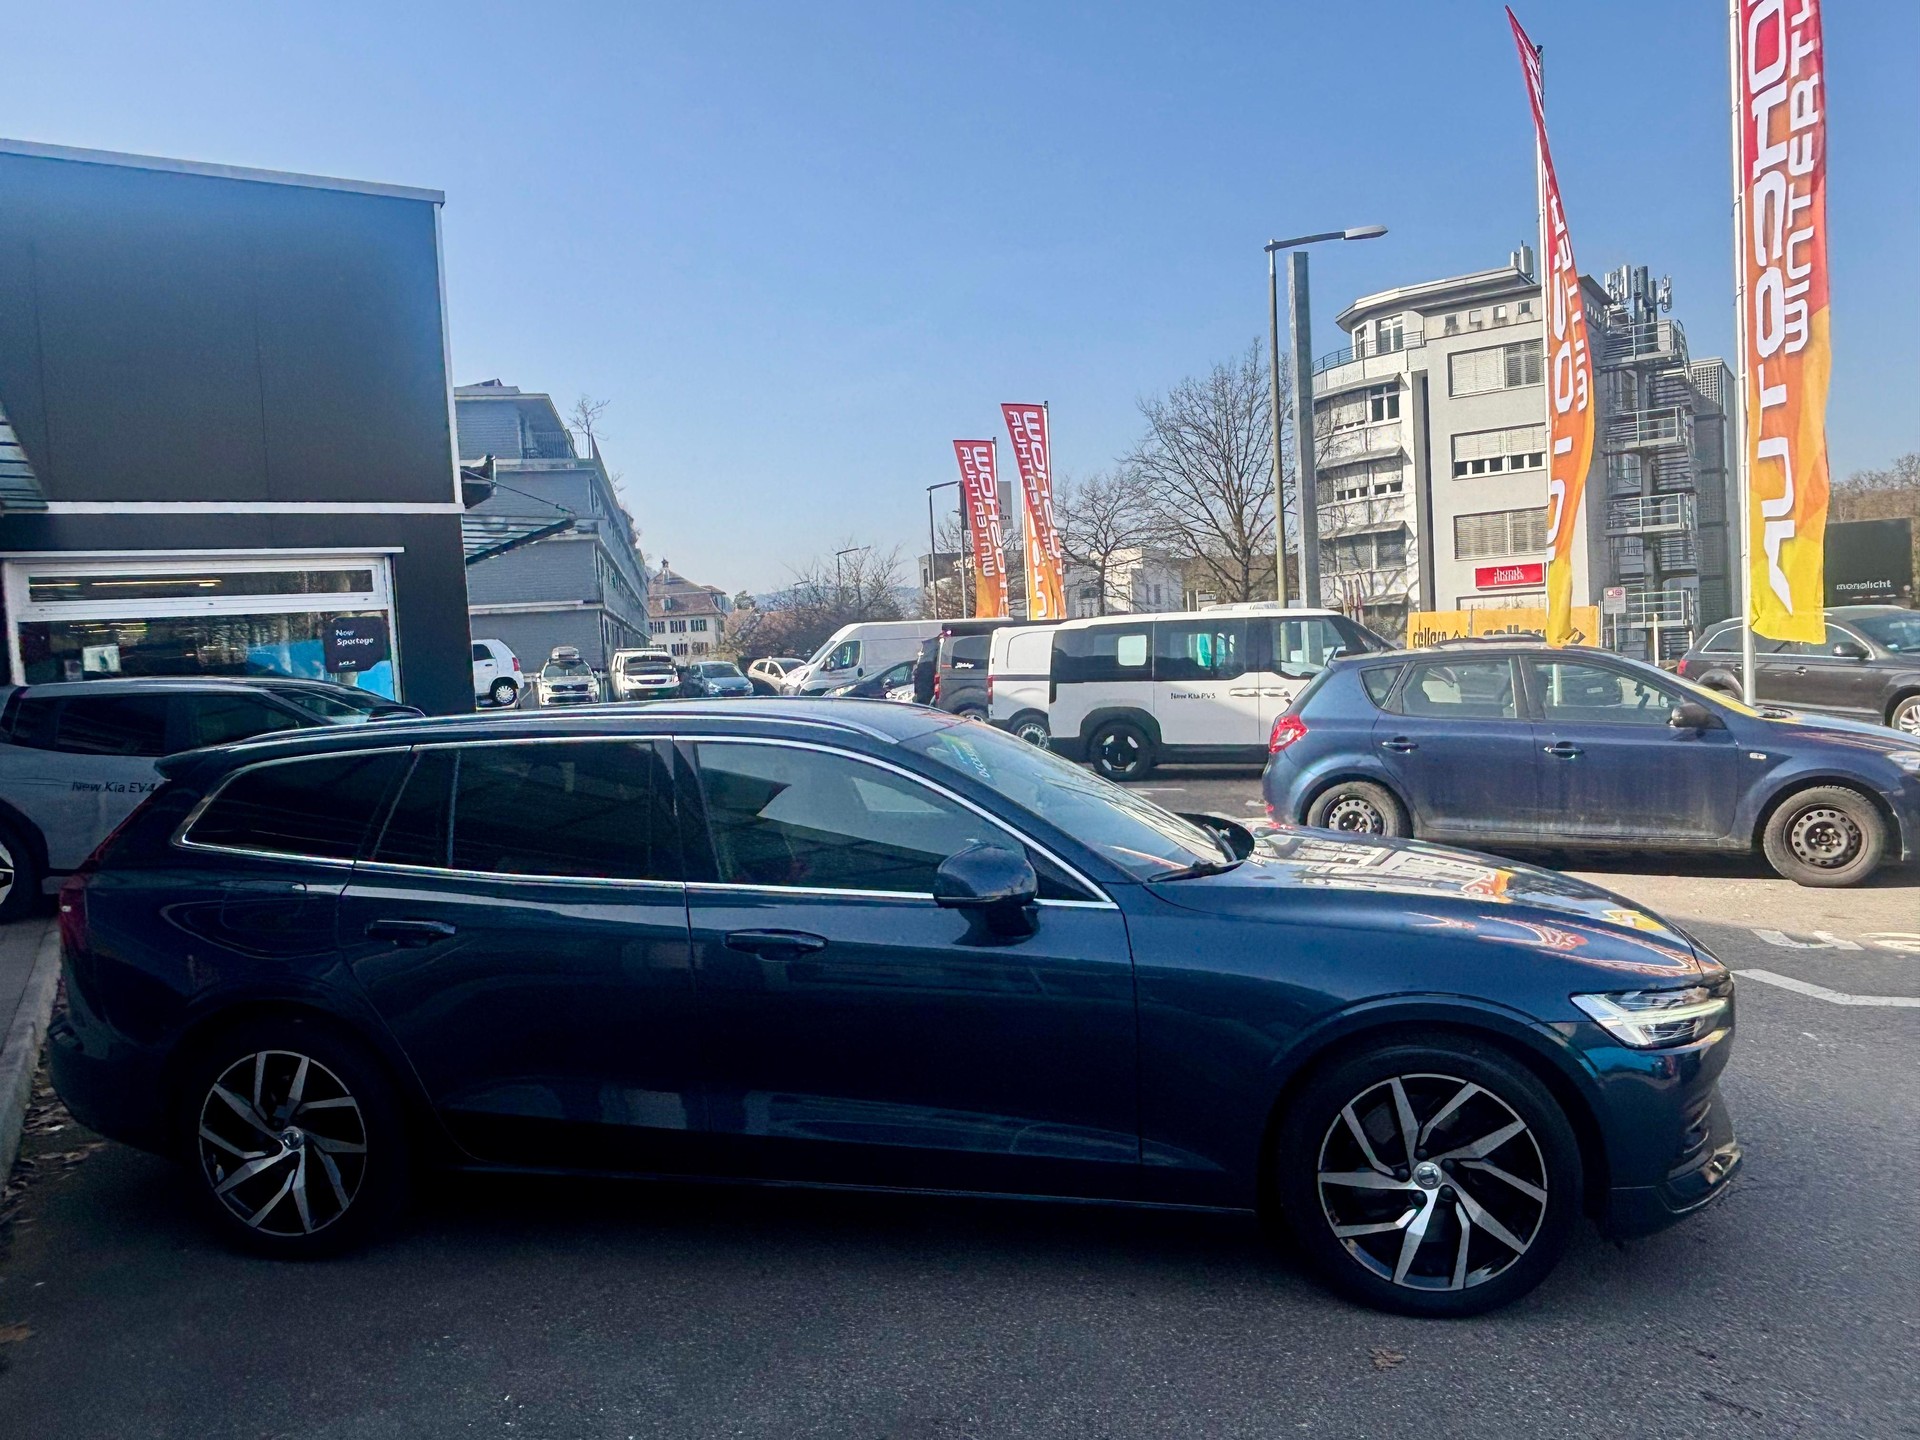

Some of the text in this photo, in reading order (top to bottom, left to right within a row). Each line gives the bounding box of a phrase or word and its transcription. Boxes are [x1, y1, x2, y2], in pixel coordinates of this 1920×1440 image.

[1746, 0, 1795, 615] AUTOSHO
[1836, 579, 1892, 590] monolicht
[72, 781, 102, 791] New
[104, 781, 125, 792] Kia
